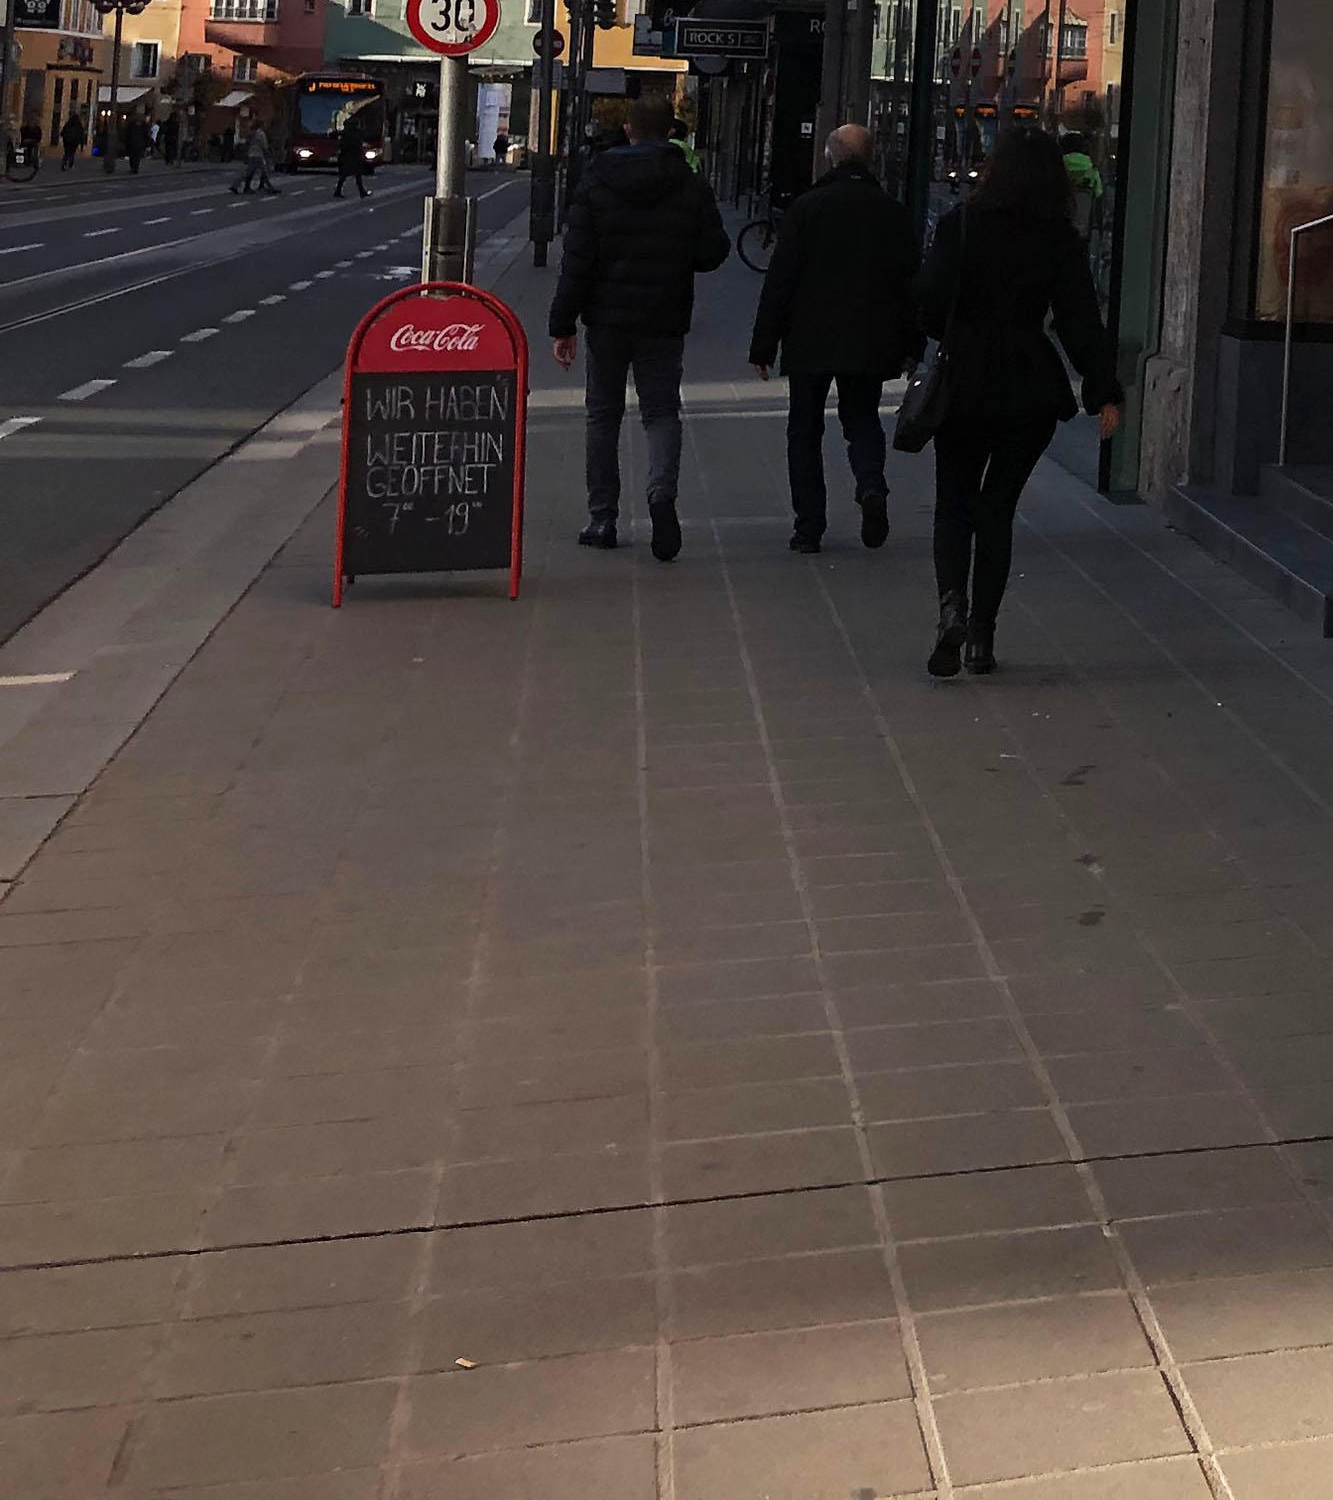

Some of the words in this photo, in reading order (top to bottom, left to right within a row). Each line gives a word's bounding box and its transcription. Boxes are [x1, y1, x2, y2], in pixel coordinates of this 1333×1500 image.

[390, 323, 486, 352] Coca-Cola
[366, 386, 415, 420] WIR
[425, 385, 508, 420] HABEN
